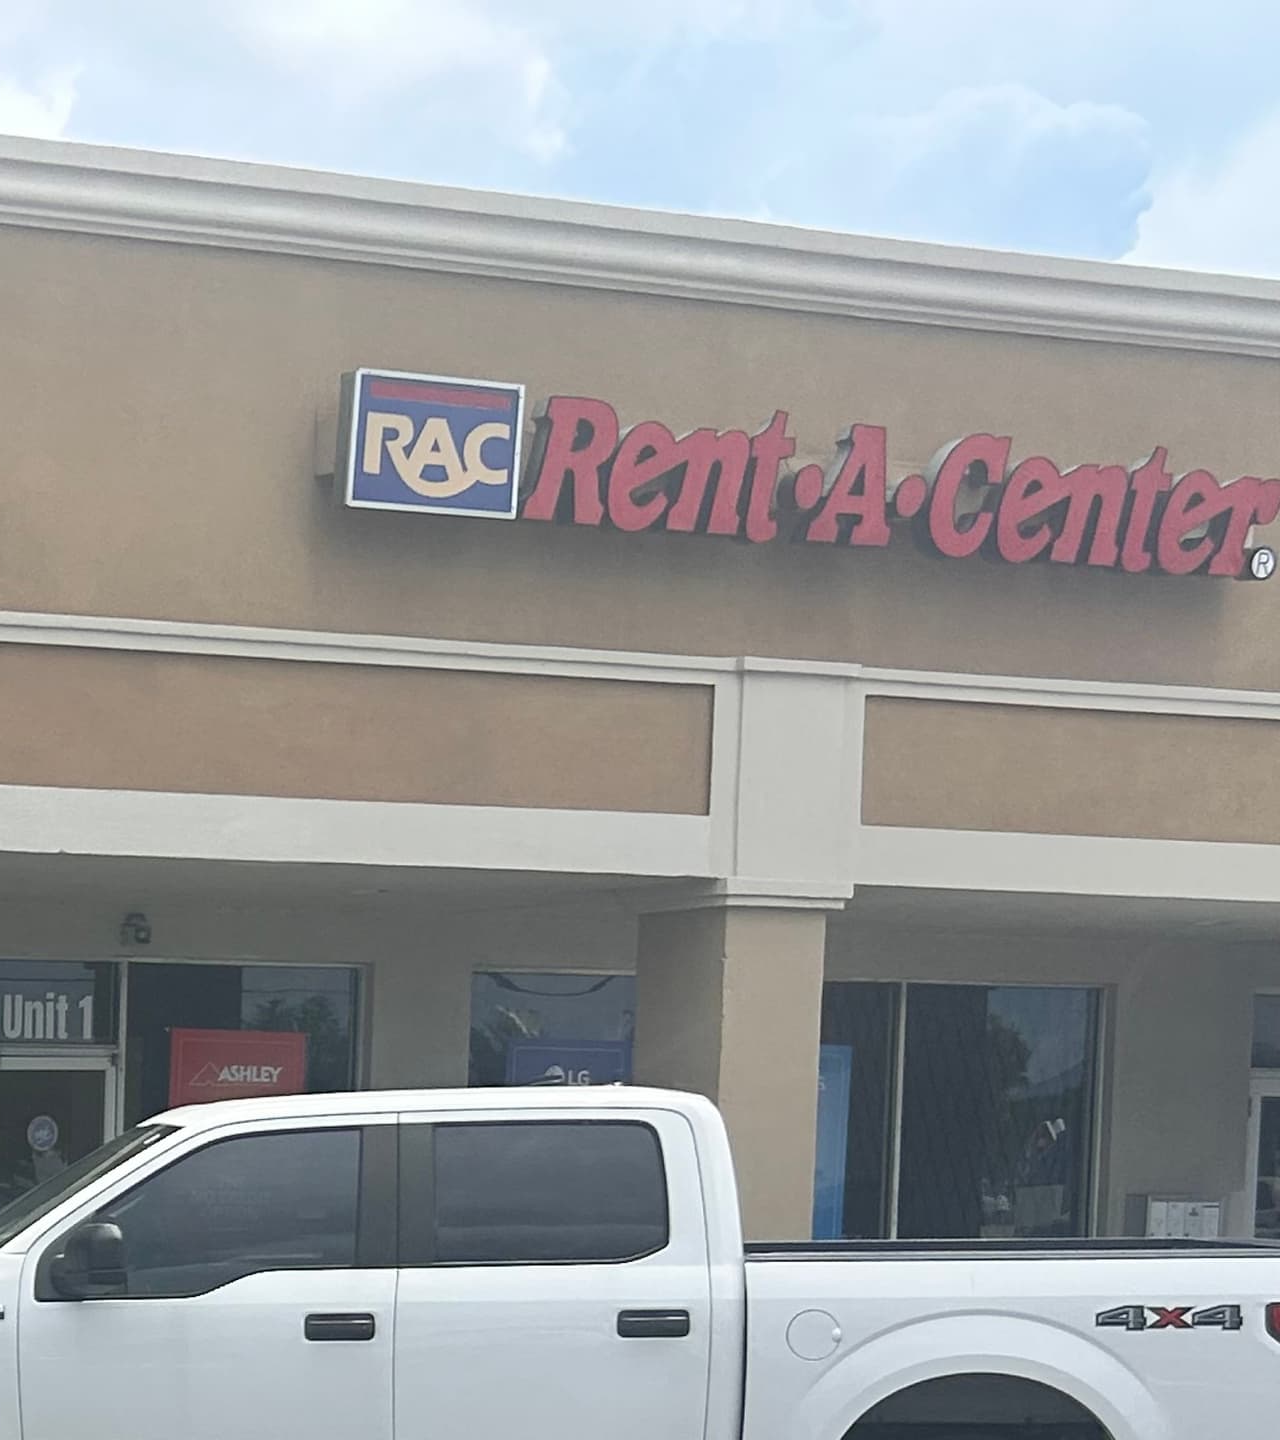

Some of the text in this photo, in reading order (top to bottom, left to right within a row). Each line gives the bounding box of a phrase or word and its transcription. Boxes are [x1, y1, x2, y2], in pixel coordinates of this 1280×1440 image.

[363, 411, 510, 498] RAC
[2, 992, 94, 1040] Unit 1
[218, 1065, 283, 1083] ASHLEY
[567, 1070, 590, 1085] LG
